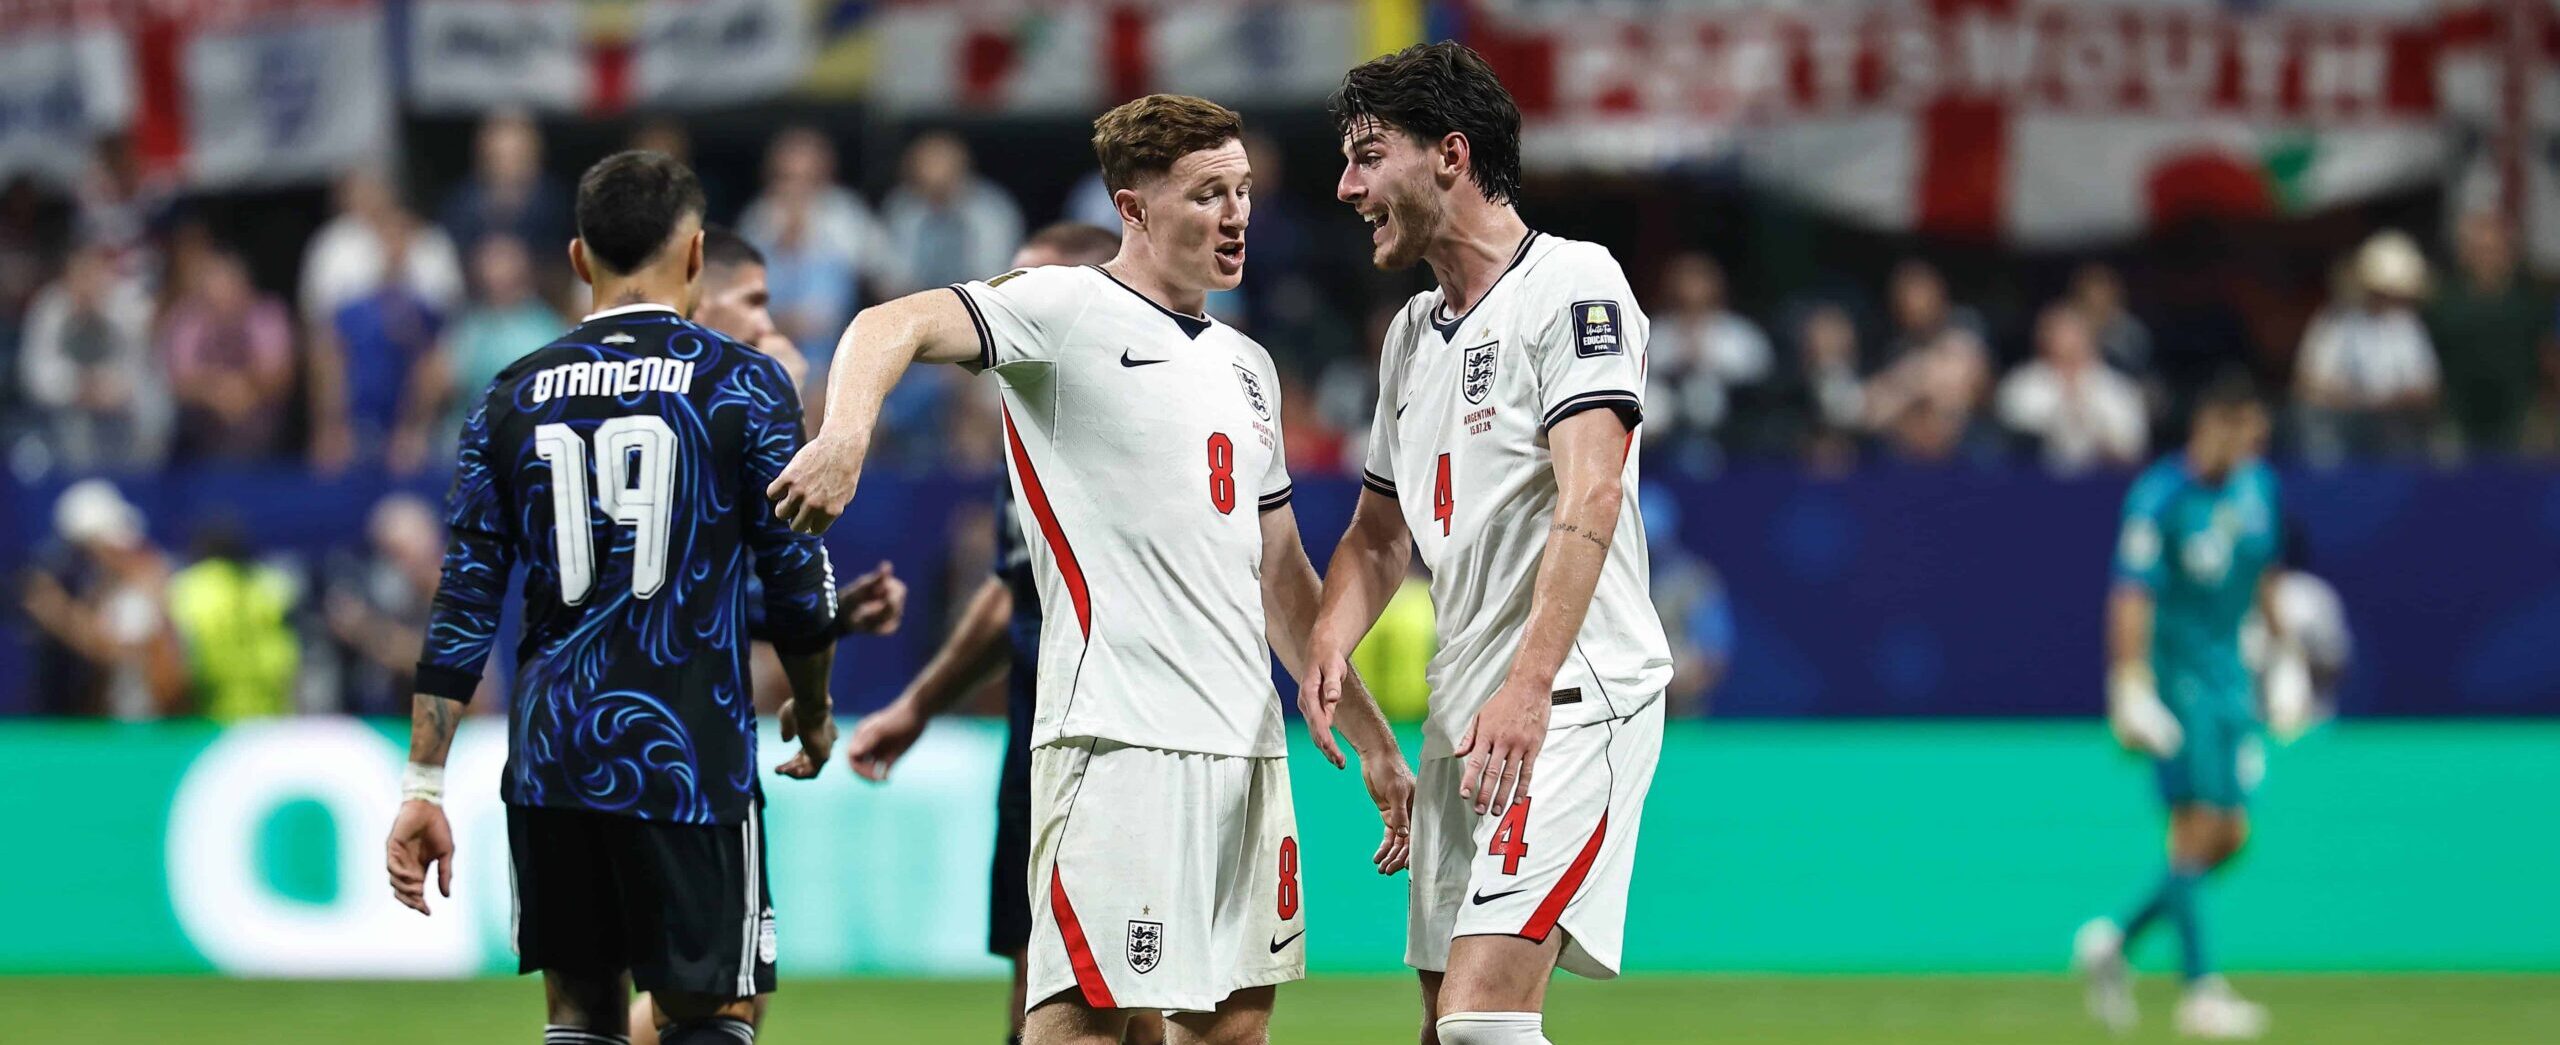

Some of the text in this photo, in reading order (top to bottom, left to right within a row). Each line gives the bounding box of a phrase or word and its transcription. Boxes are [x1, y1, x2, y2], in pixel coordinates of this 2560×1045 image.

[1556, 15, 2392, 113] PORTSMOUTH
[533, 356, 695, 403] OTAMENDI
[1583, 335, 1617, 346] EDUCATION
[1464, 406, 1497, 426] ARGENTINA
[535, 415, 678, 606] 19
[1207, 431, 1236, 516] 8
[1434, 452, 1455, 537] 4
[1277, 835, 1299, 921] 8
[1488, 795, 1532, 876] 4
